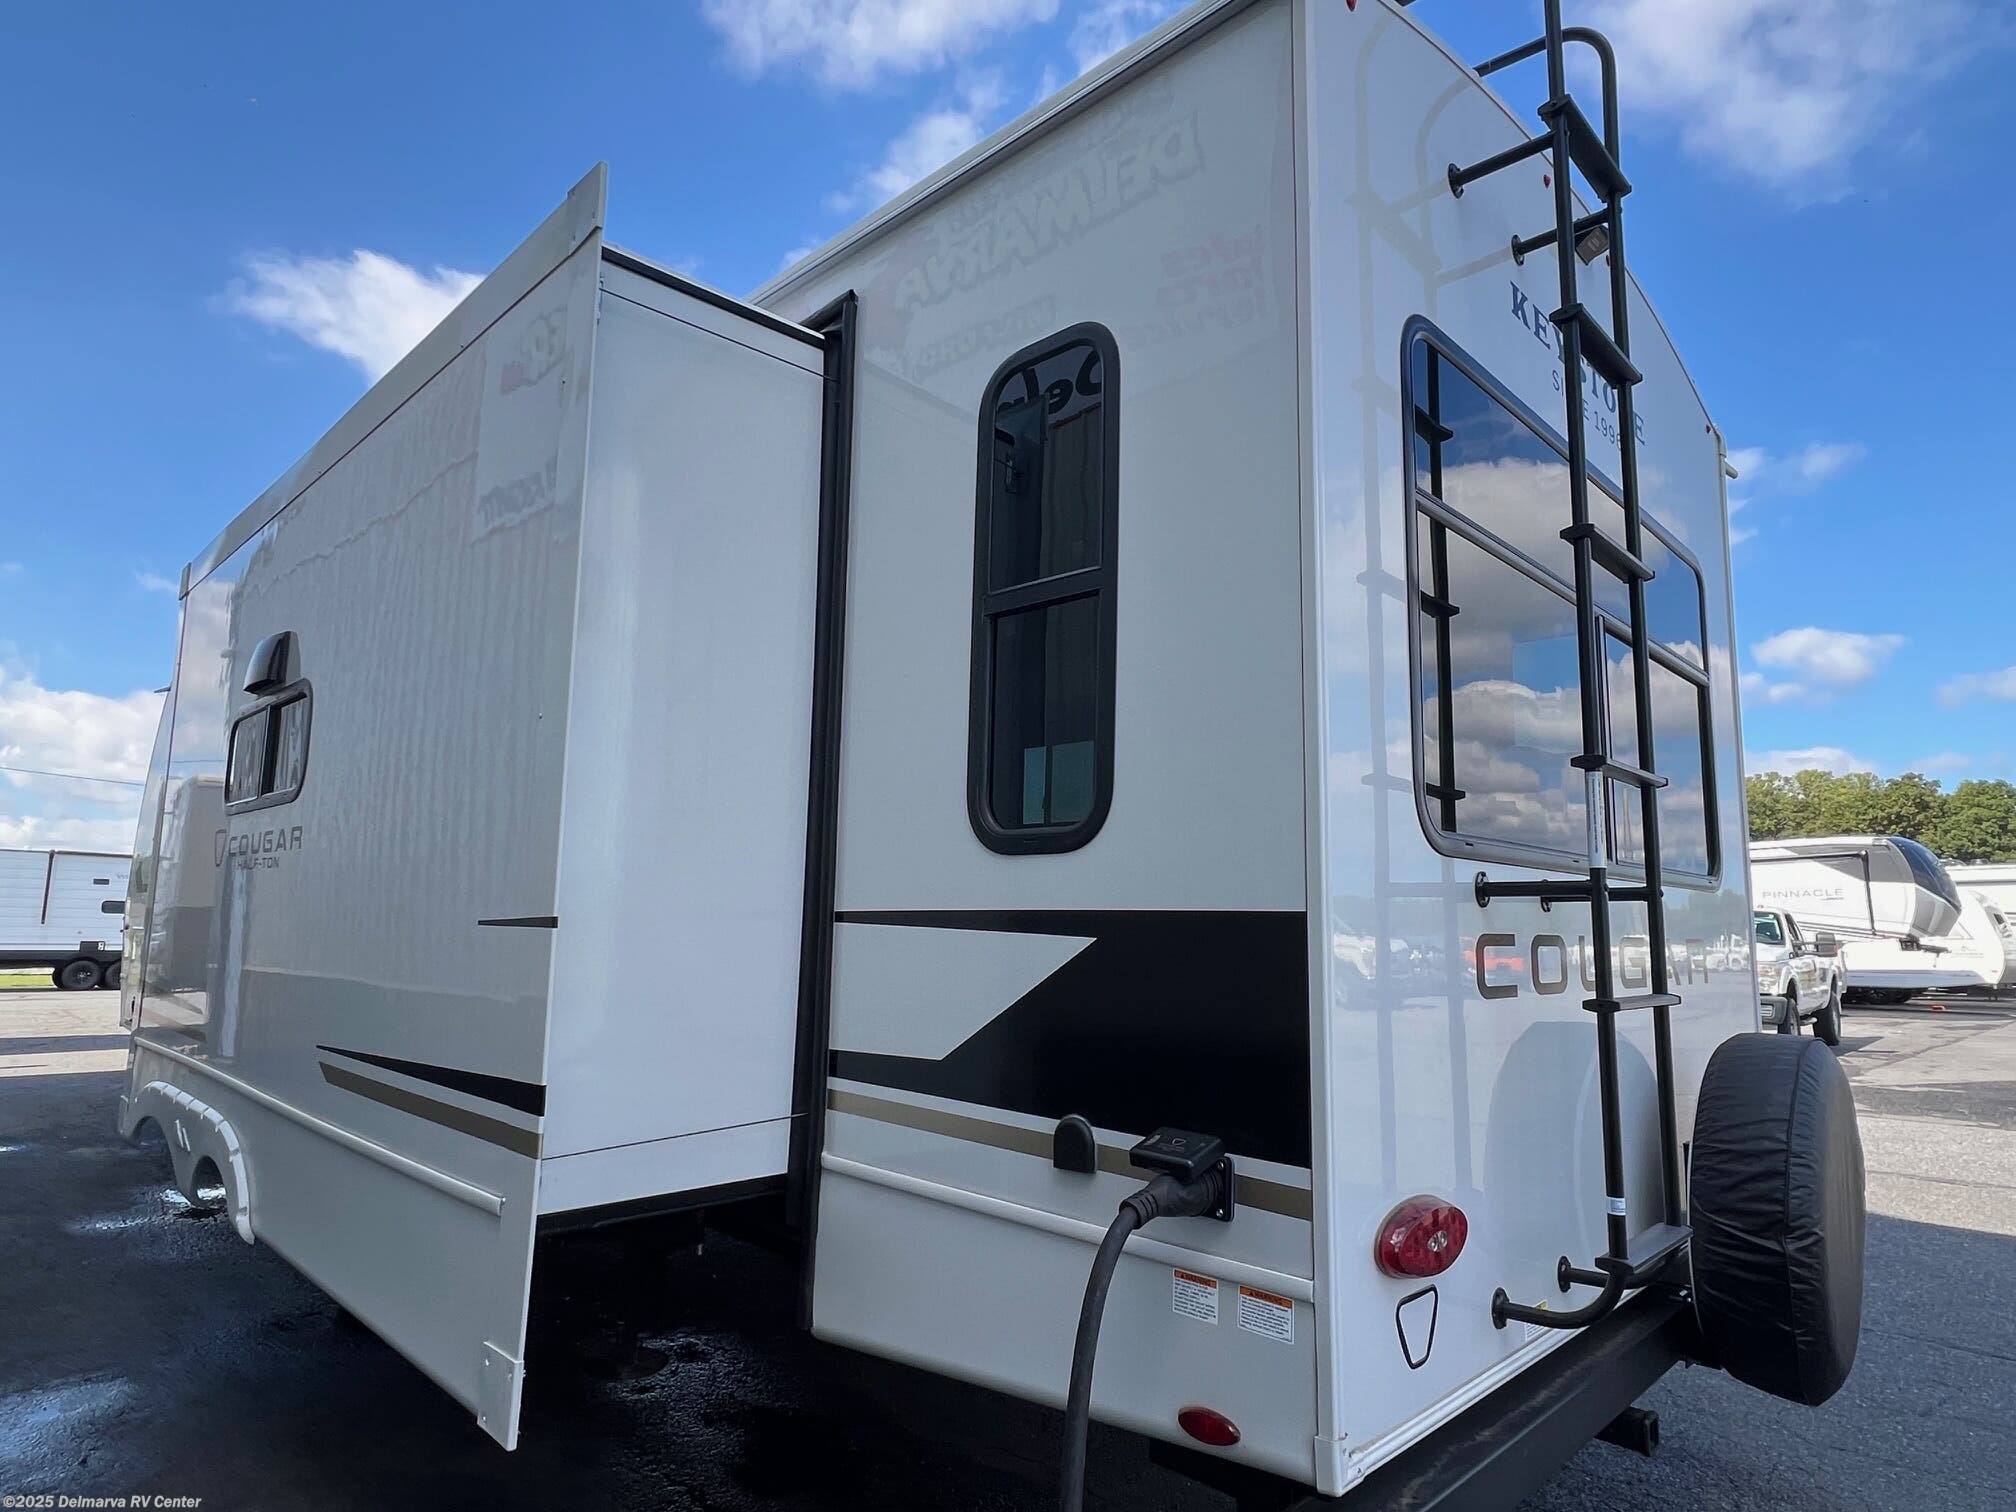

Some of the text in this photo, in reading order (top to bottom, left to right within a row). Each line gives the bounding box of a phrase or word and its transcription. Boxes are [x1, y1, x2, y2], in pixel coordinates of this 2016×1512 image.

[1510, 281, 1645, 446] KEYTOE
[1552, 369, 1590, 421] SIE
[229, 826, 303, 857] COUGAR
[1762, 888, 1844, 898] PINNACLE
